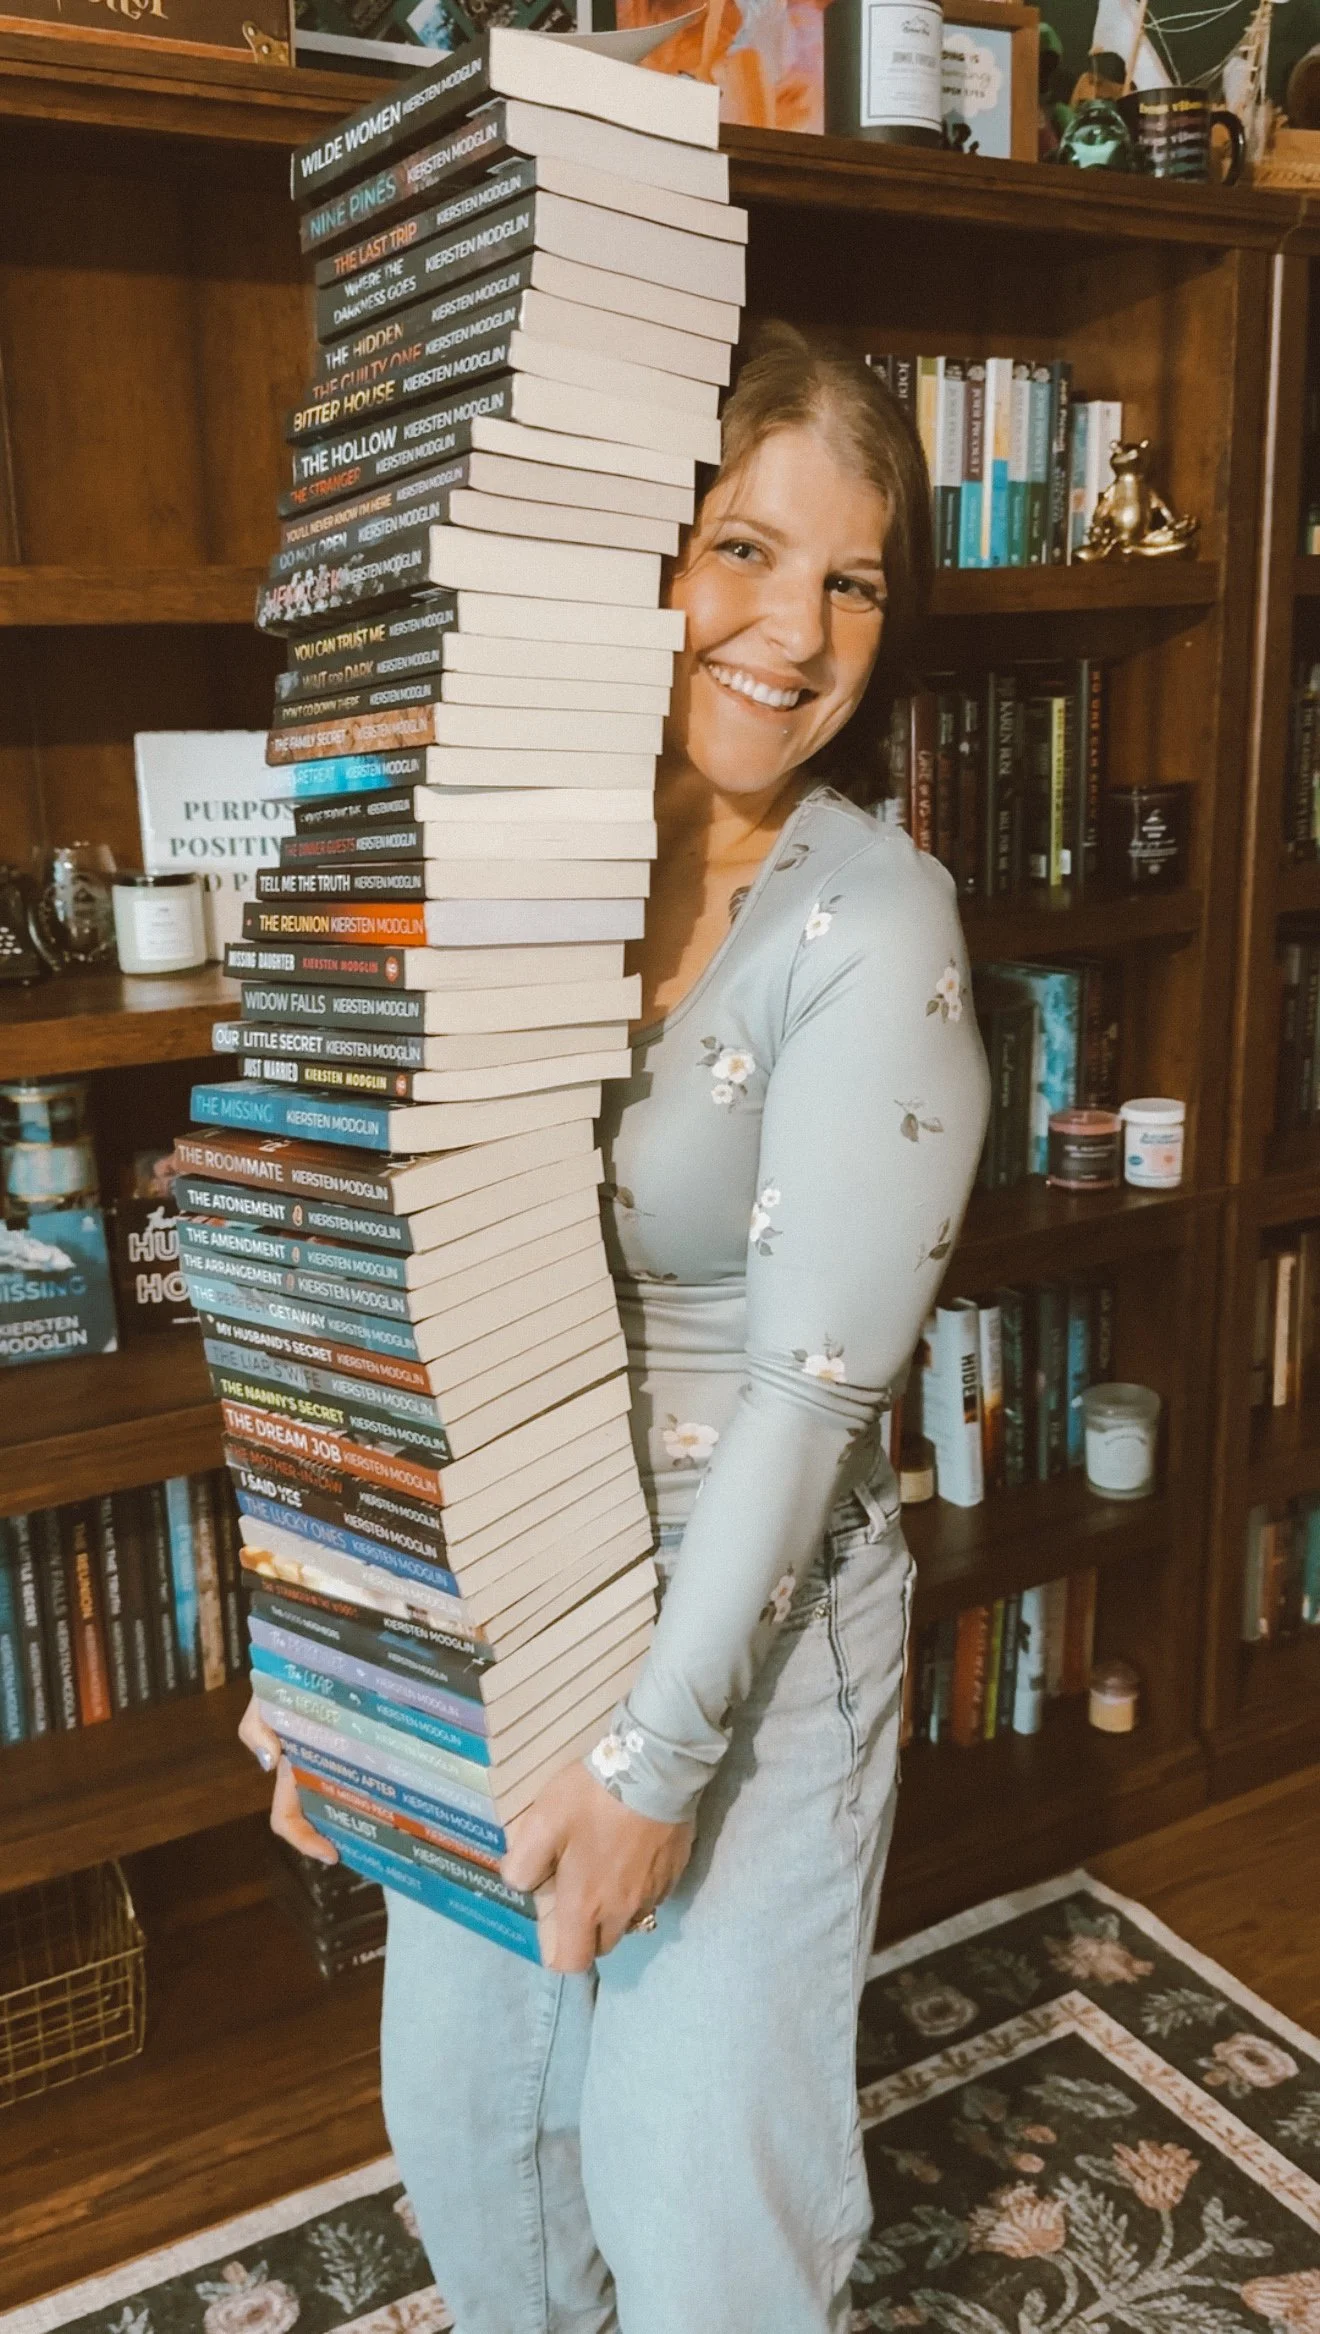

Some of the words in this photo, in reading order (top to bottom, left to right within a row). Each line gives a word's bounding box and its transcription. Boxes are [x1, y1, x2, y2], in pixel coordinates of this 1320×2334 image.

[402, 85, 441, 115] KIERSTEN
[440, 58, 482, 93] MODGLIN
[301, 136, 343, 178] WILDE
[345, 101, 401, 152] WOMEN
[407, 145, 451, 184] KIERSTEN
[450, 122, 498, 159] MODGLIN
[310, 207, 345, 238] NINE
[350, 174, 397, 217] PINES
[334, 254, 360, 276] THE
[359, 233, 389, 265] LAST
[388, 221, 418, 251] TRIP
[425, 240, 477, 274] KIERSTEN
[475, 212, 530, 251] MODGLIN
[344, 269, 383, 298] WHERE
[384, 258, 404, 279] THE
[334, 287, 388, 325] DARKNESS
[387, 275, 417, 302] GOES
[431, 293, 475, 322] KIERSTEN
[473, 272, 520, 304] MODGLIN
[325, 345, 350, 370] THE
[353, 322, 405, 357] HIDDEN
[425, 328, 469, 356] KIERSTEN
[467, 307, 517, 340] MODGLIN
[312, 380, 338, 400] THE
[340, 356, 388, 391] GUILTY
[389, 343, 422, 368] ONE
[402, 361, 453, 393] KIERSTEN
[451, 345, 506, 376] MODGLIN
[896, 360, 911, 399] JODI
[293, 399, 340, 432] BITTER
[343, 380, 396, 413] HOUSE
[404, 410, 453, 440] KIERSTEN
[452, 391, 504, 425] MODGLIN
[301, 450, 329, 478] THE
[331, 426, 398, 467] HOLLOW
[308, 465, 361, 498] STRANGER
[358, 518, 398, 543] KIERSTEN
[398, 502, 440, 529] MODGLIN
[320, 531, 348, 552] OPEN
[336, 628, 370, 651] TRUST
[369, 623, 387, 642] ME
[184, 800, 295, 821] PURPOS
[170, 836, 281, 857] POSITIV
[259, 876, 281, 892] TELL
[281, 876, 297, 892] ME
[298, 876, 317, 892] THE
[317, 874, 350, 892] TRUTH
[353, 876, 387, 889] KIERSTEN
[259, 914, 280, 932] THE
[281, 915, 330, 933] REUNION
[331, 917, 376, 934] KIERSTEN
[375, 918, 424, 935] MODGLIN
[258, 951, 296, 971] DAUGHTER
[302, 957, 338, 972] KIERSTEN
[340, 958, 379, 974] MODGLIN
[244, 990, 289, 1012] WIDOW
[290, 993, 326, 1015] FALLS
[332, 997, 375, 1015] KIERSTEN
[375, 1000, 420, 1018] MODGLIN
[215, 1028, 240, 1046] OUR
[243, 1031, 279, 1050] LITTLE
[279, 1034, 324, 1054] SECRET
[326, 1039, 373, 1058] KIERSTEN
[372, 1041, 421, 1061] MODGLIN
[243, 1058, 262, 1077] JUST
[263, 1059, 298, 1083] MARRIED
[304, 1067, 343, 1085] KIERSTEN
[345, 1071, 387, 1090] MODGLIN
[195, 1094, 219, 1116] THE
[221, 1096, 273, 1123] MISSING
[286, 1109, 331, 1130] KIERSTEN
[332, 1116, 379, 1137] MODGLIN
[177, 1144, 203, 1165] THE
[205, 1150, 284, 1183] ROOMMATE
[291, 1168, 339, 1190] KIERSTEN
[338, 1177, 388, 1201] MODGLIN
[187, 1188, 212, 1209] THE
[212, 1193, 286, 1220] ATONEMENT
[186, 1226, 210, 1244] THE
[211, 1231, 286, 1260] AMENDMENT
[308, 1211, 353, 1232] KIERSTEN
[352, 1220, 402, 1241] MODGLIN
[128, 1231, 180, 1262] HU
[307, 1250, 353, 1270] KIERSTEN
[352, 1258, 398, 1280] MODGLIN
[136, 1272, 190, 1304] HO
[183, 1253, 205, 1270] THE
[203, 1256, 283, 1287] ARRANGEMENT
[193, 1284, 215, 1303] THE
[268, 1303, 326, 1330] GETAWAY
[297, 1277, 350, 1303] KIERSTEN
[348, 1288, 406, 1314] MODGLIN
[216, 1321, 233, 1337] MY
[233, 1324, 292, 1354] HUSBAND'S
[292, 1339, 333, 1363] SECRET
[327, 1318, 372, 1340] KIERSTEN
[370, 1329, 416, 1350] MODGLIN
[336, 1352, 380, 1375] KIERSTEN
[378, 1363, 424, 1387] MODGLIN
[961, 1352, 976, 1398] HIDE
[220, 1377, 244, 1397] THE
[244, 1382, 297, 1412] NANNY'S
[297, 1398, 345, 1424] SECRET
[331, 1378, 381, 1402] KIERSTEN
[380, 1391, 434, 1417] MODGLIN
[225, 1408, 255, 1434] THE
[255, 1417, 308, 1452] DREAM
[310, 1437, 342, 1463] JOB
[349, 1415, 398, 1440] KIERSTEN
[396, 1426, 447, 1452] MODGLIN
[247, 1473, 277, 1498] SAID
[278, 1485, 303, 1509] YES
[343, 1452, 390, 1478] KIERSTEN
[388, 1466, 437, 1494] MODGLIN
[245, 1495, 272, 1519] THE
[309, 1521, 346, 1551] ONES
[359, 1491, 400, 1514] KIERSTEN
[398, 1504, 441, 1529] MODGLIN
[343, 1512, 389, 1541] KIERSTEN
[387, 1527, 438, 1560] MODGLIN
[351, 1538, 398, 1568] KIERSTEN
[396, 1556, 449, 1588] MODGLIN
[383, 1617, 429, 1641] KIERSTEN
[427, 1629, 476, 1655] MODGLIN
[360, 1769, 396, 1799] AFTER
[323, 1803, 353, 1829] THE
[351, 1817, 378, 1840] LIST
[402, 1791, 451, 1823] KIERSTEN
[449, 1811, 500, 1845] MODGLIN
